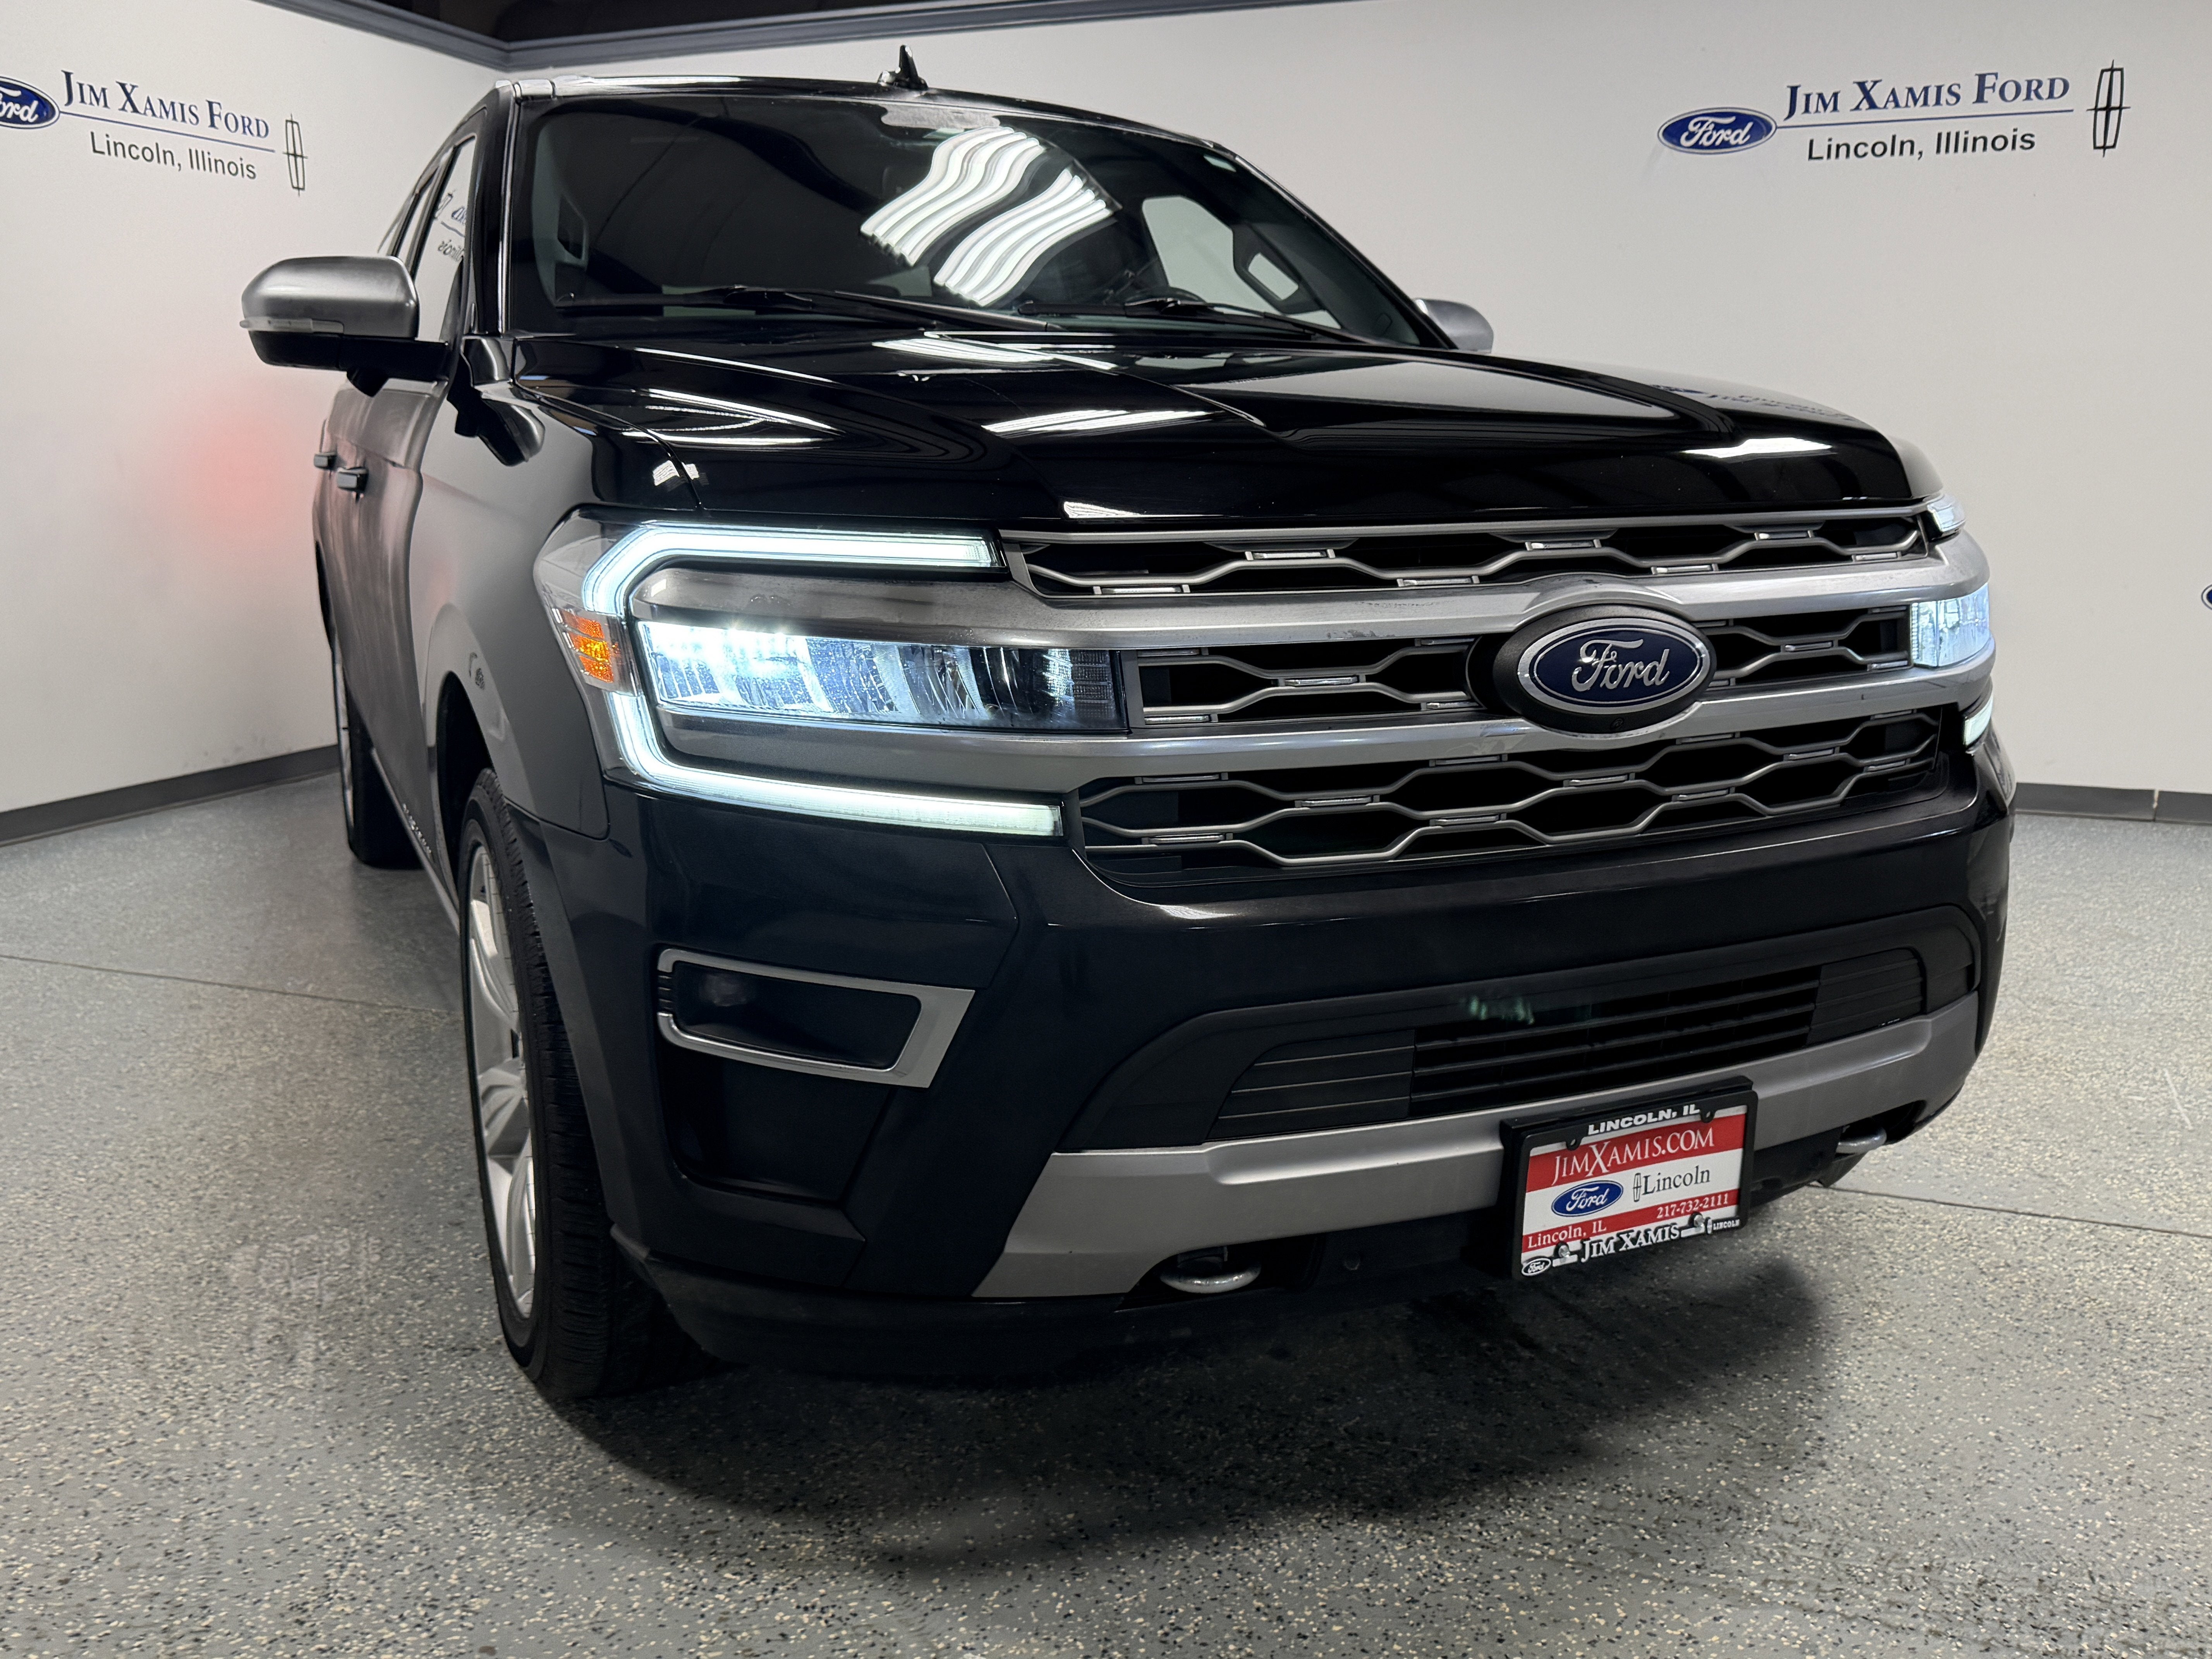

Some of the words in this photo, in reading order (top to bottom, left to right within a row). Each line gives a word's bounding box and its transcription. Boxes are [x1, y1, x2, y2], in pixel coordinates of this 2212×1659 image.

[0, 86, 38, 122] ord
[61, 70, 110, 109] JIM
[116, 81, 200, 126] XAMIS
[206, 99, 270, 139] FORD
[1783, 84, 1840, 121] JIM
[1850, 79, 1961, 111] XAMIS
[1972, 72, 2069, 104] FORD
[1680, 116, 1753, 147] Ford
[1808, 134, 1923, 161] Lincoln,
[1936, 127, 2035, 155] Illinois
[91, 131, 182, 172] Lincoln,
[189, 148, 257, 180] Illinois
[1571, 639, 1670, 692] Ford
[1588, 1108, 1677, 1135] LINCOLN,
[1683, 1104, 1700, 1115] IL
[1551, 1127, 1714, 1186] JIMXAMIS.COM
[1642, 1165, 1710, 1195] Lincoln
[1566, 1186, 1609, 1211] Ford
[1657, 1193, 1728, 1219] 217-732-2111
[1528, 1225, 1586, 1249] Lincoln,
[1592, 1220, 1606, 1233] IL
[1713, 1219, 1740, 1231] LINCOLN
[1581, 1239, 1615, 1262] JIM
[1619, 1224, 1680, 1250] XAMIS
